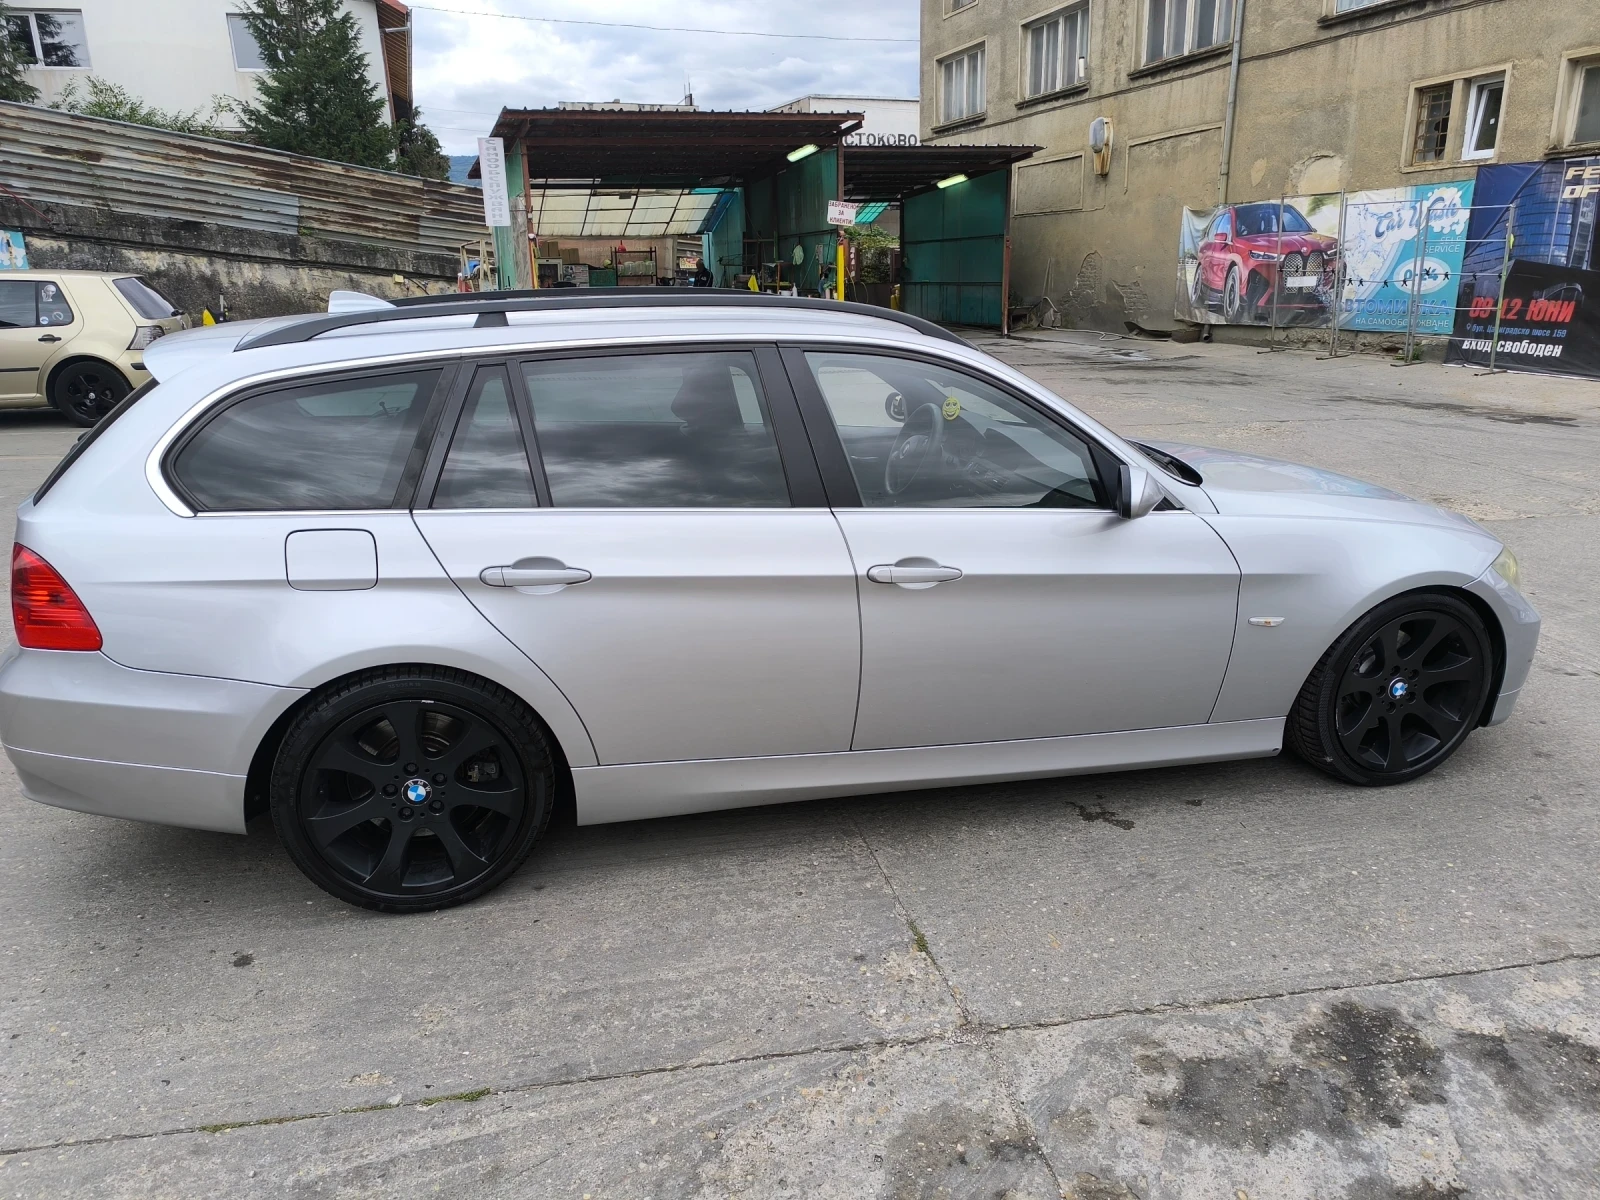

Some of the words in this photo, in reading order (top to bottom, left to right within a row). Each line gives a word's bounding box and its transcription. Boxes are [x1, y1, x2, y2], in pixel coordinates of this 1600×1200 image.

[1375, 211, 1405, 238] Car
[1425, 244, 1460, 254] SERVICE
[1525, 298, 1576, 323] ЮНИ
[1355, 317, 1366, 325] НА
[1367, 317, 1450, 328] САМООБСЖВАНЕ
[1486, 324, 1530, 335] Цаиградско
